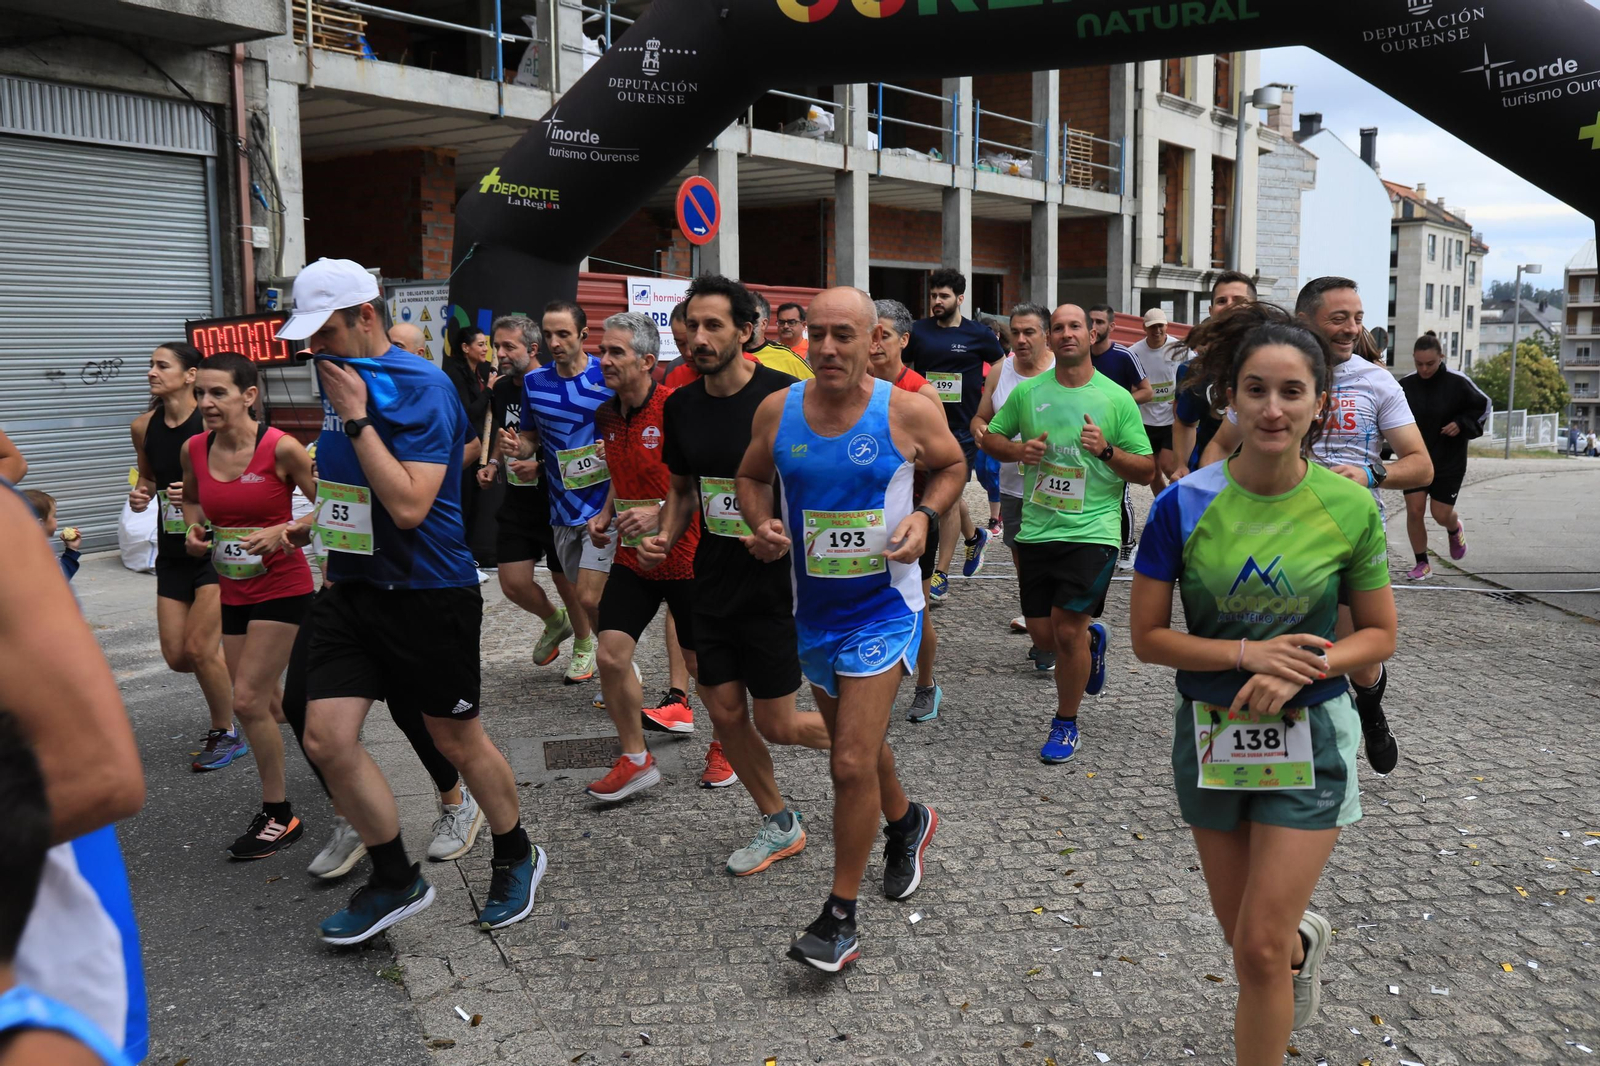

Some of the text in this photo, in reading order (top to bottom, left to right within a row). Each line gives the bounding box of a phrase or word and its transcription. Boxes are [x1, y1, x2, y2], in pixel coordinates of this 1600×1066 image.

[1362, 7, 1485, 42] DEPUTACIÓN
[1381, 27, 1470, 53] OURENSE
[1498, 57, 1578, 88] inorde
[608, 77, 698, 93] DEPUTACIÓN
[1502, 78, 1600, 108] turismo Our
[617, 91, 686, 104] OURENSE
[551, 125, 600, 144] inorde
[549, 146, 640, 162] turismo Ourense
[508, 196, 521, 206] La
[936, 381, 953, 389] 199
[1341, 399, 1355, 408] DE
[577, 458, 591, 471] 10
[1049, 478, 1070, 491] 112
[331, 504, 349, 521] 53
[829, 531, 866, 548] 193
[1233, 727, 1281, 750] 138
